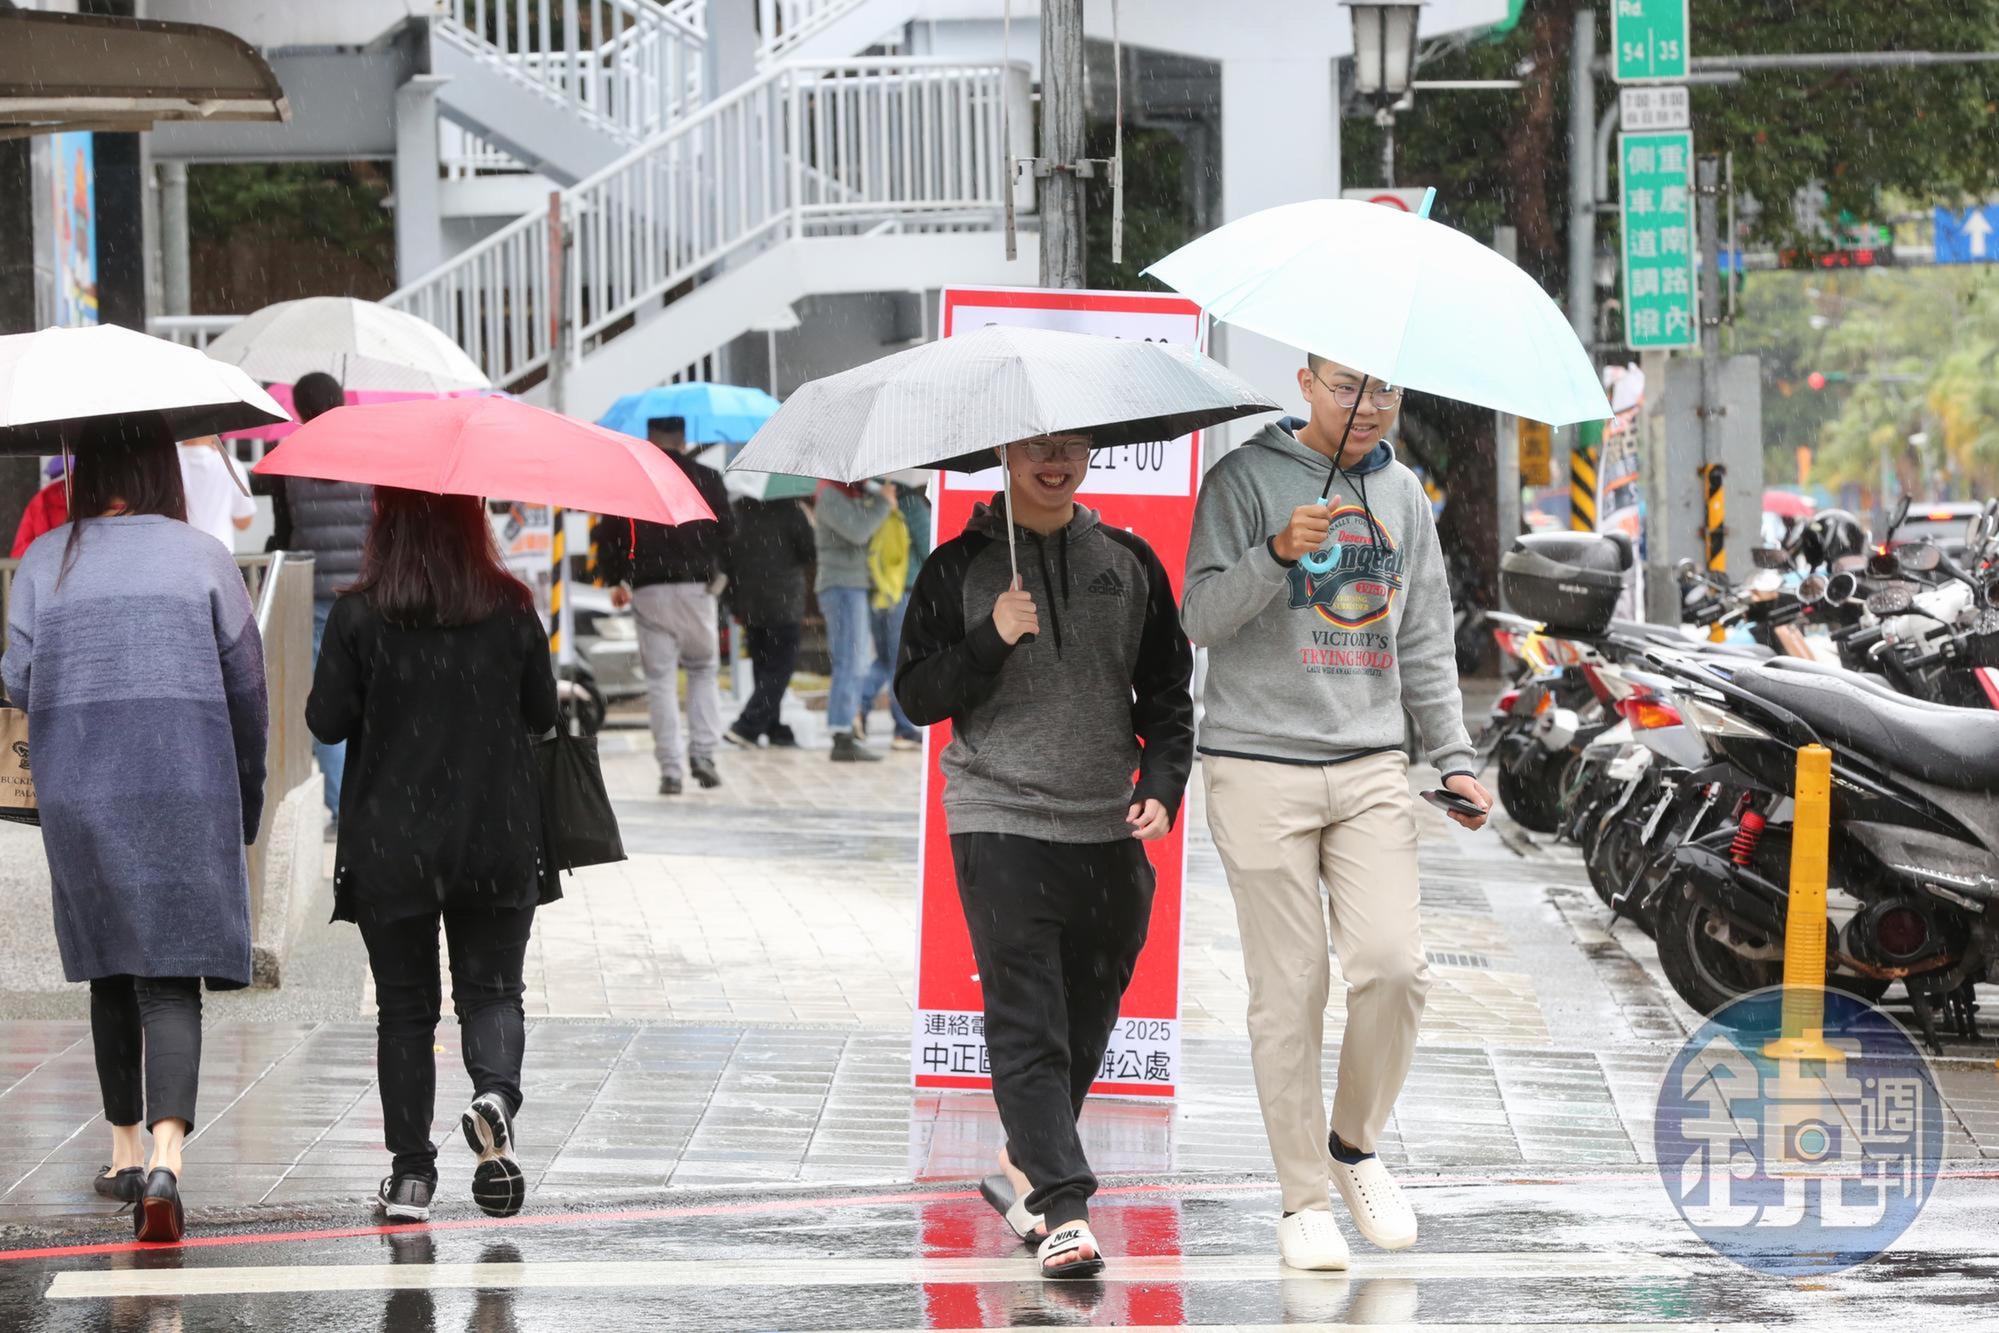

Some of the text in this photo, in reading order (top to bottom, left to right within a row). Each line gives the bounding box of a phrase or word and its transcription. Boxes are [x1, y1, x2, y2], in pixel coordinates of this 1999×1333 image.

[1623, 41, 1645, 62] 54
[1659, 39, 1680, 61] 35
[1628, 146, 1661, 337] 側車道調撥
[1659, 145, 1690, 337] 重慶南路內
[1089, 440, 1164, 471] 21:00
[1312, 630, 1389, 650] VICTORY'S
[1054, 1229, 1081, 1243] NIKE
